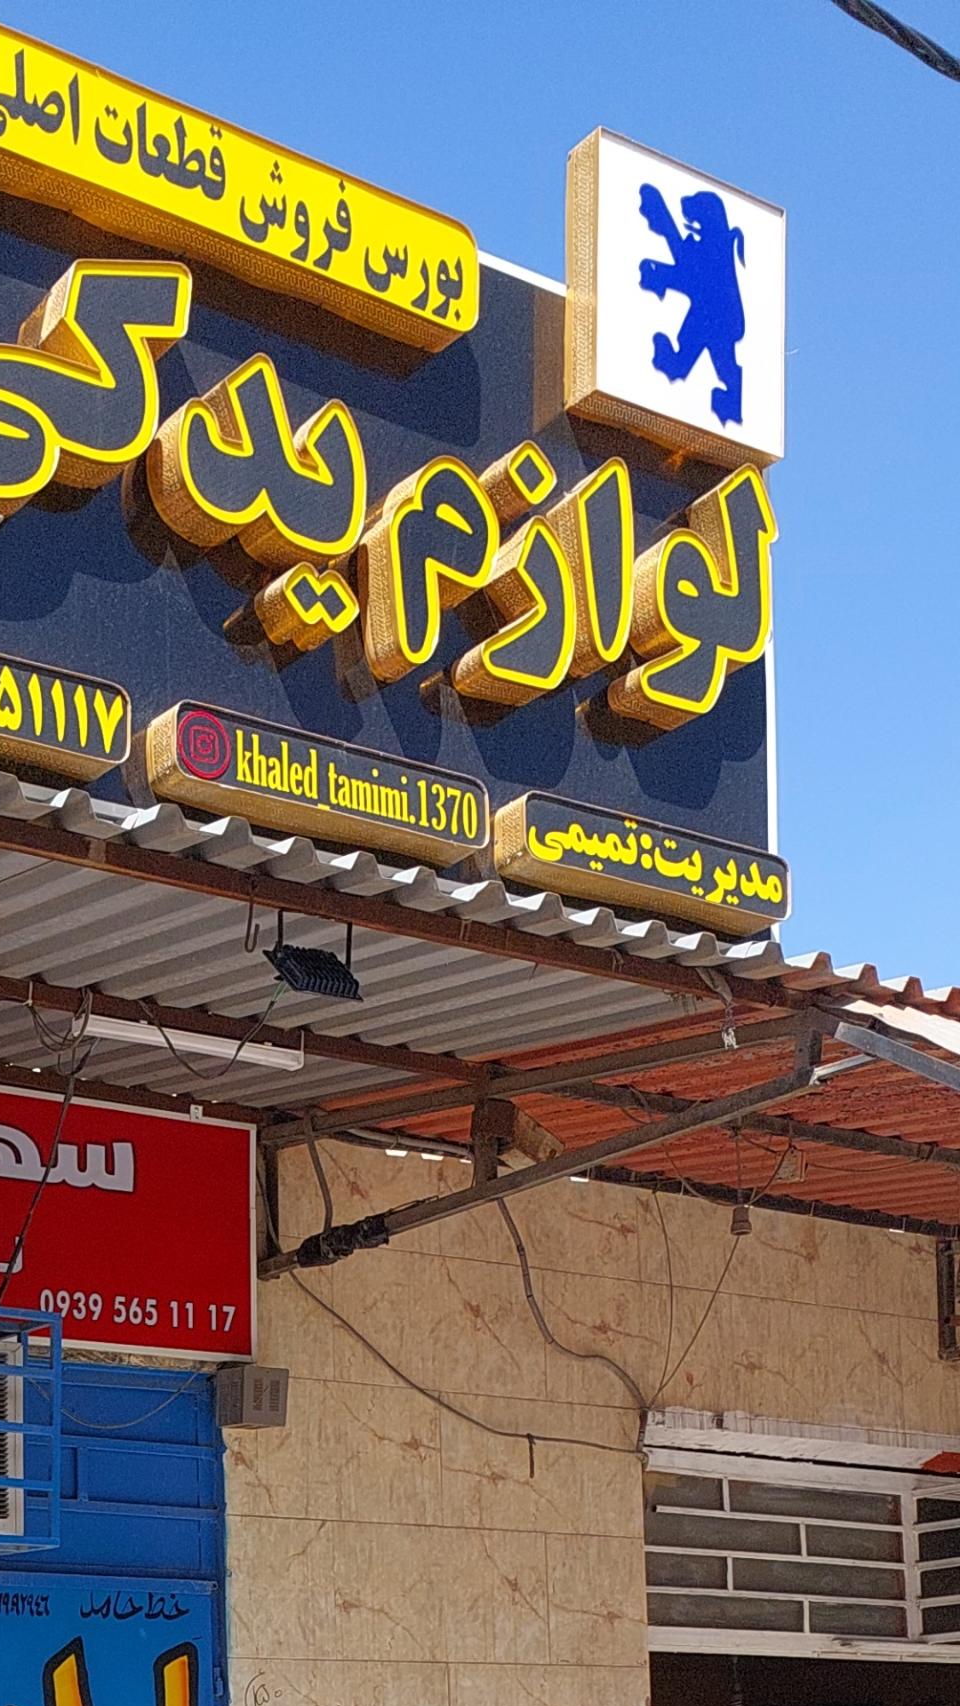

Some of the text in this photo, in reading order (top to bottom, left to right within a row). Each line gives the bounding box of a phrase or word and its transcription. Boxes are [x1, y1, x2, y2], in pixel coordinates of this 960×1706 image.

[95, 102, 226, 200] قطعات
[240, 160, 352, 270] فروش
[364, 244, 463, 322] بورس
[375, 441, 778, 720] لوازم
[236, 730, 478, 841] khaled_tamimi.1370
[40, 1289, 236, 1332] 0939 565 11 17
[145, 1591, 189, 1620] خط
